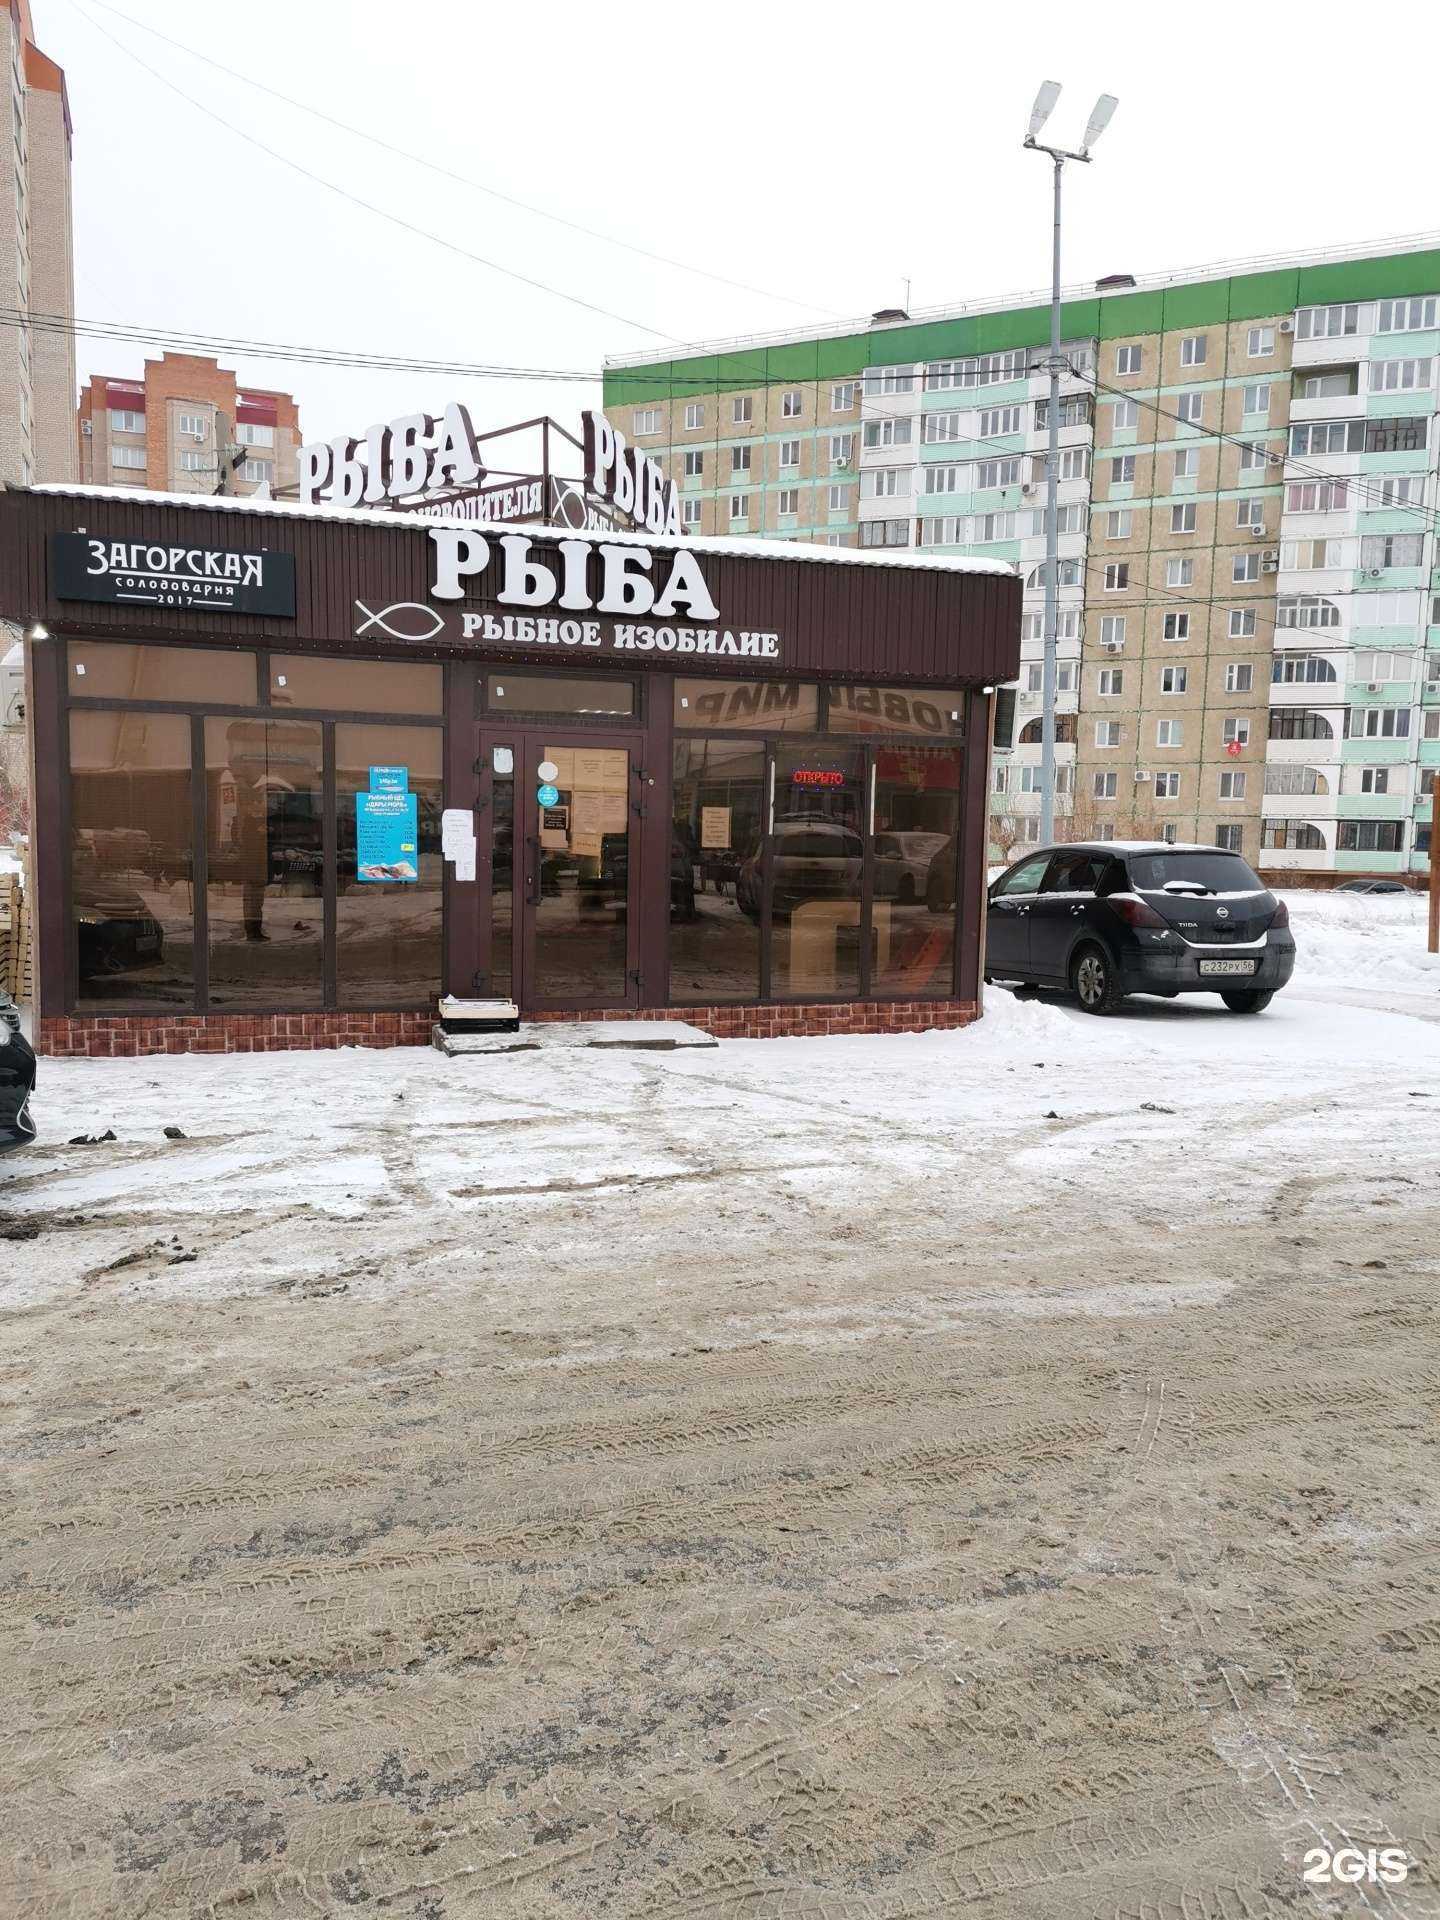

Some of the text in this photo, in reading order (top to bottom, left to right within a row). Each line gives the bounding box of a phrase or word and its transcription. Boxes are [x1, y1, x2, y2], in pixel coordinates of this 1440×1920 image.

[298, 402, 483, 508] РЫБА
[590, 411, 682, 535] РЫБА
[409, 482, 542, 521] ВОДИТЕЛЯ
[87, 540, 263, 587] ЗАГОРСКАЯ
[428, 528, 720, 620] РЫБА
[157, 594, 194, 606] 2017
[461, 613, 780, 658] РЫБНОЕ ИЗОБИЛИЕ
[793, 770, 844, 785] ОТКРЫТО
